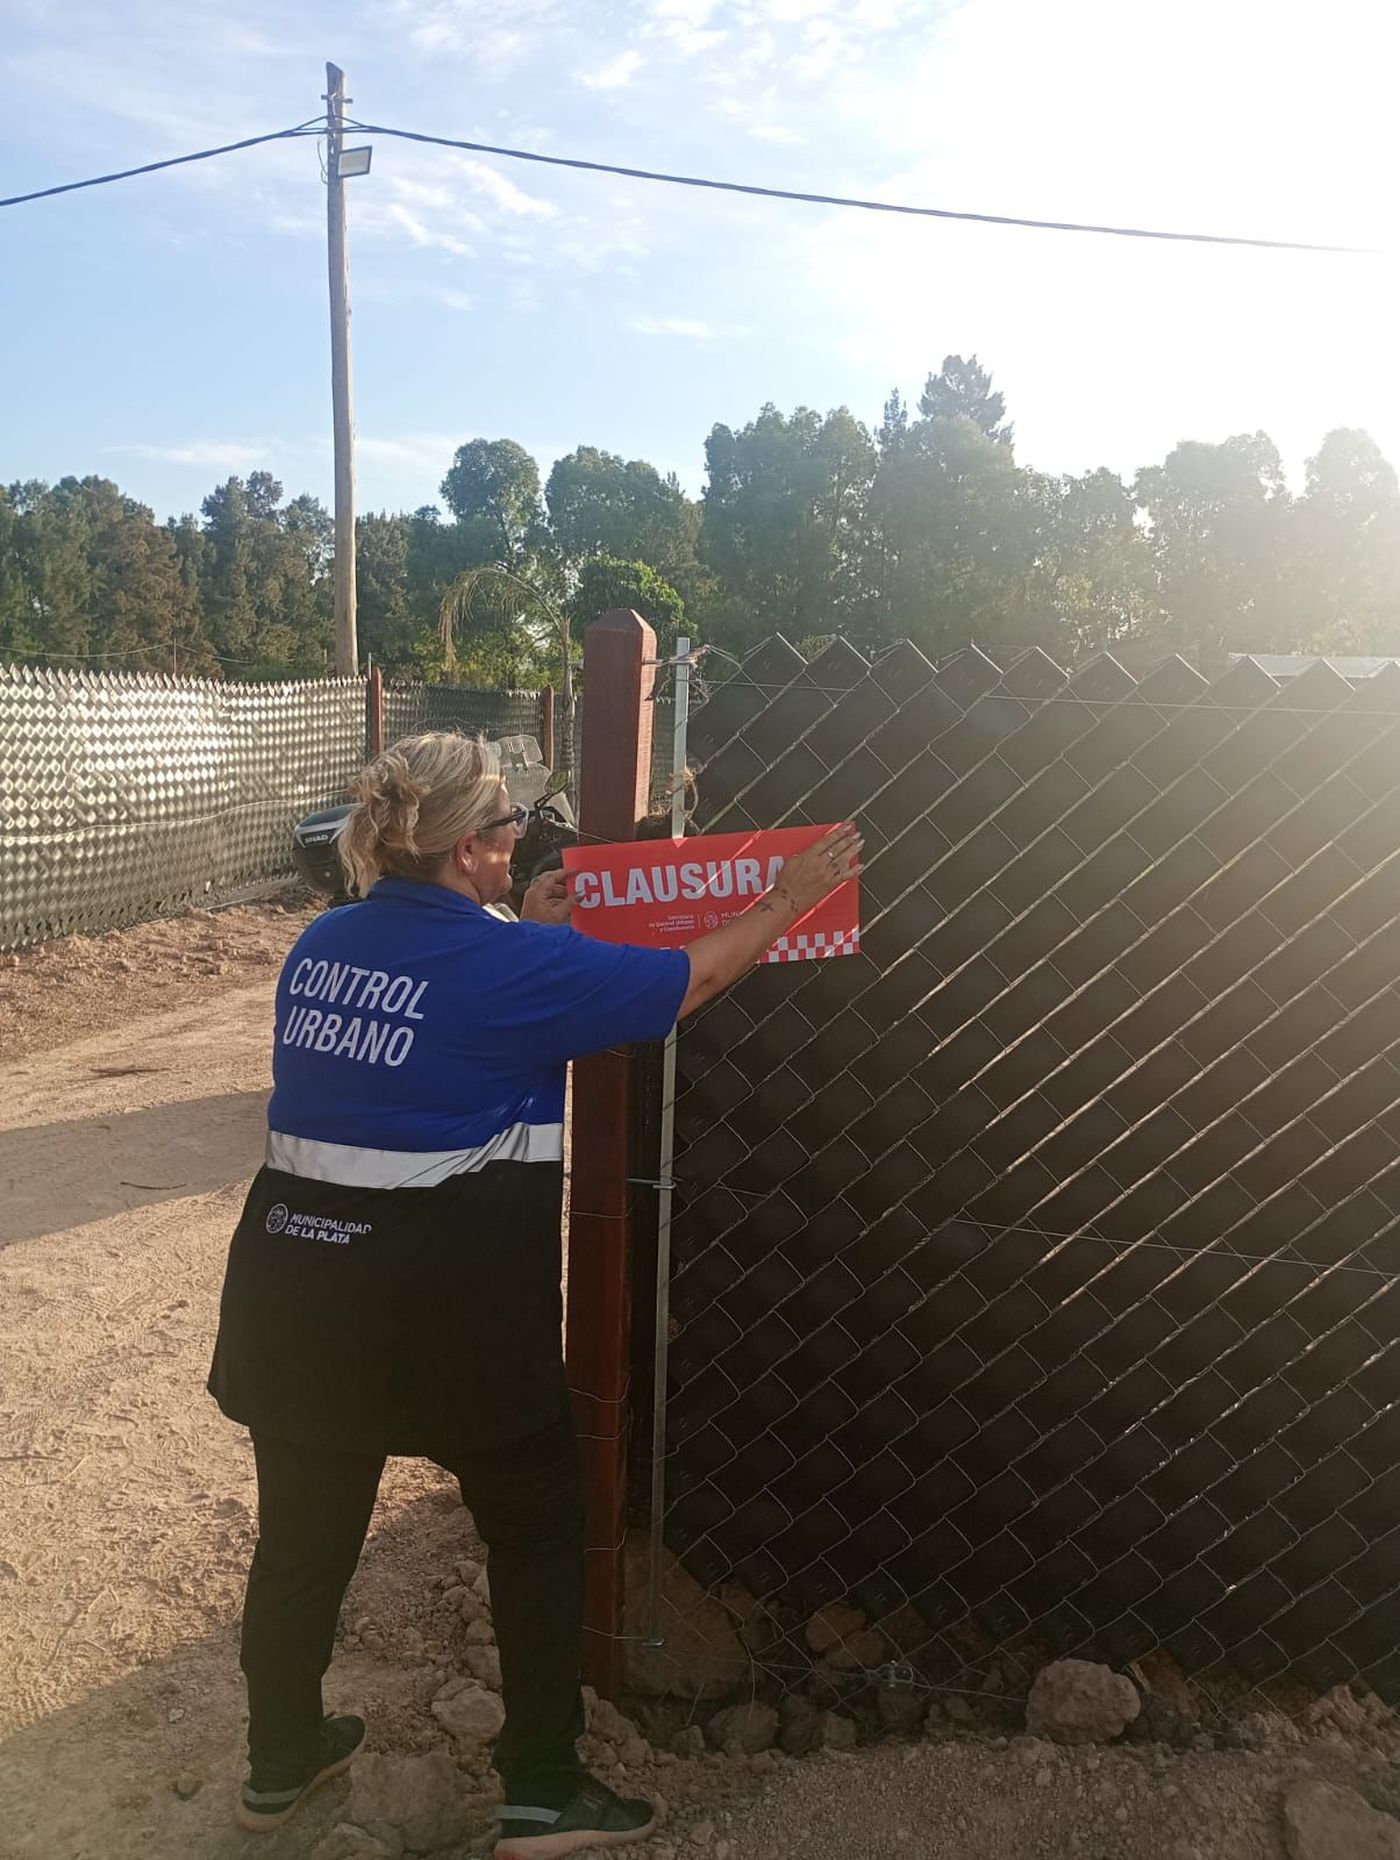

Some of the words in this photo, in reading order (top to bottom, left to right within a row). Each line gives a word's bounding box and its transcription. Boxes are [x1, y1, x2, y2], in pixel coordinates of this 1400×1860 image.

[304, 834, 329, 844] SHAD
[289, 957, 429, 1020] CONTROL
[282, 1005, 415, 1067] URBANO
[290, 1213, 372, 1233] MUNICIPALIDAD
[285, 1224, 300, 1236] DE
[301, 1227, 315, 1240] LA
[316, 1230, 351, 1244] PLATA
